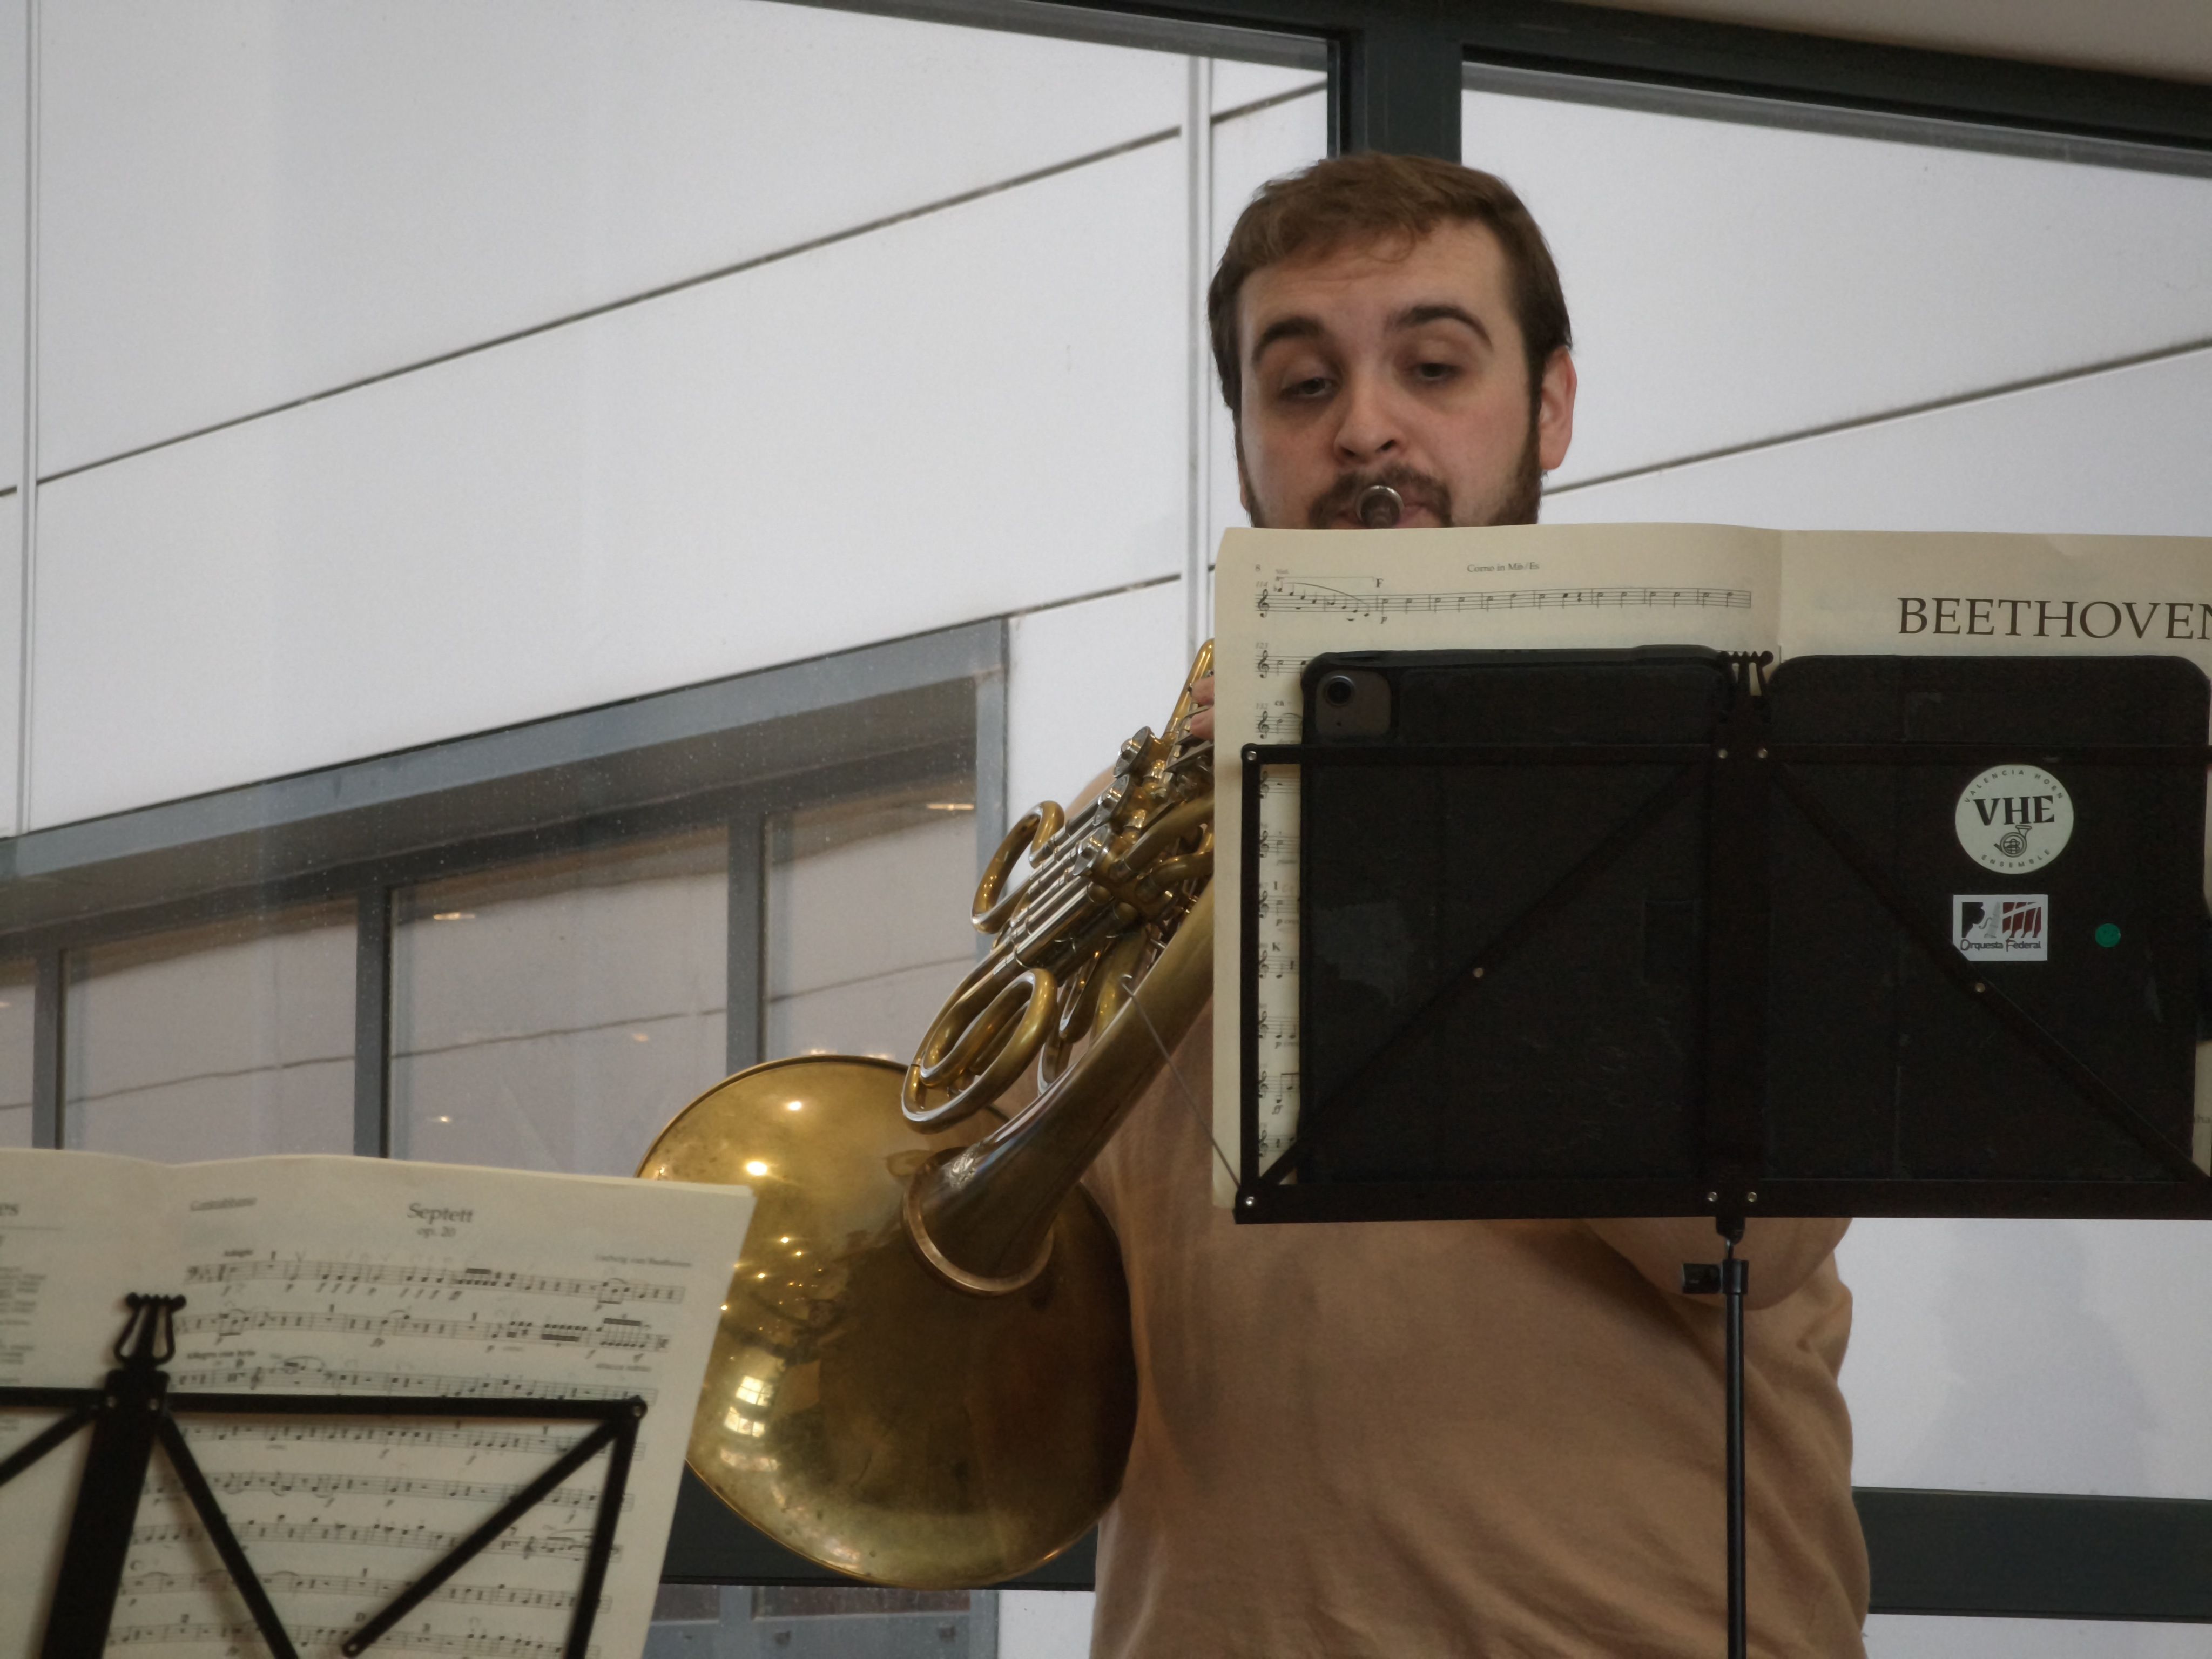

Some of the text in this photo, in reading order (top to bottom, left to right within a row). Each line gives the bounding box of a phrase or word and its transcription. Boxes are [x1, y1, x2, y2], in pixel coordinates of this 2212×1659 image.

[1467, 564, 1495, 572] Corno
[1496, 563, 1506, 571] in
[1964, 769, 2063, 804] VALENCIA HORN
[1973, 795, 2055, 826] VHE
[1981, 848, 2051, 868] ENSEMBLE
[1960, 938, 2041, 952] Orquesta Federal
